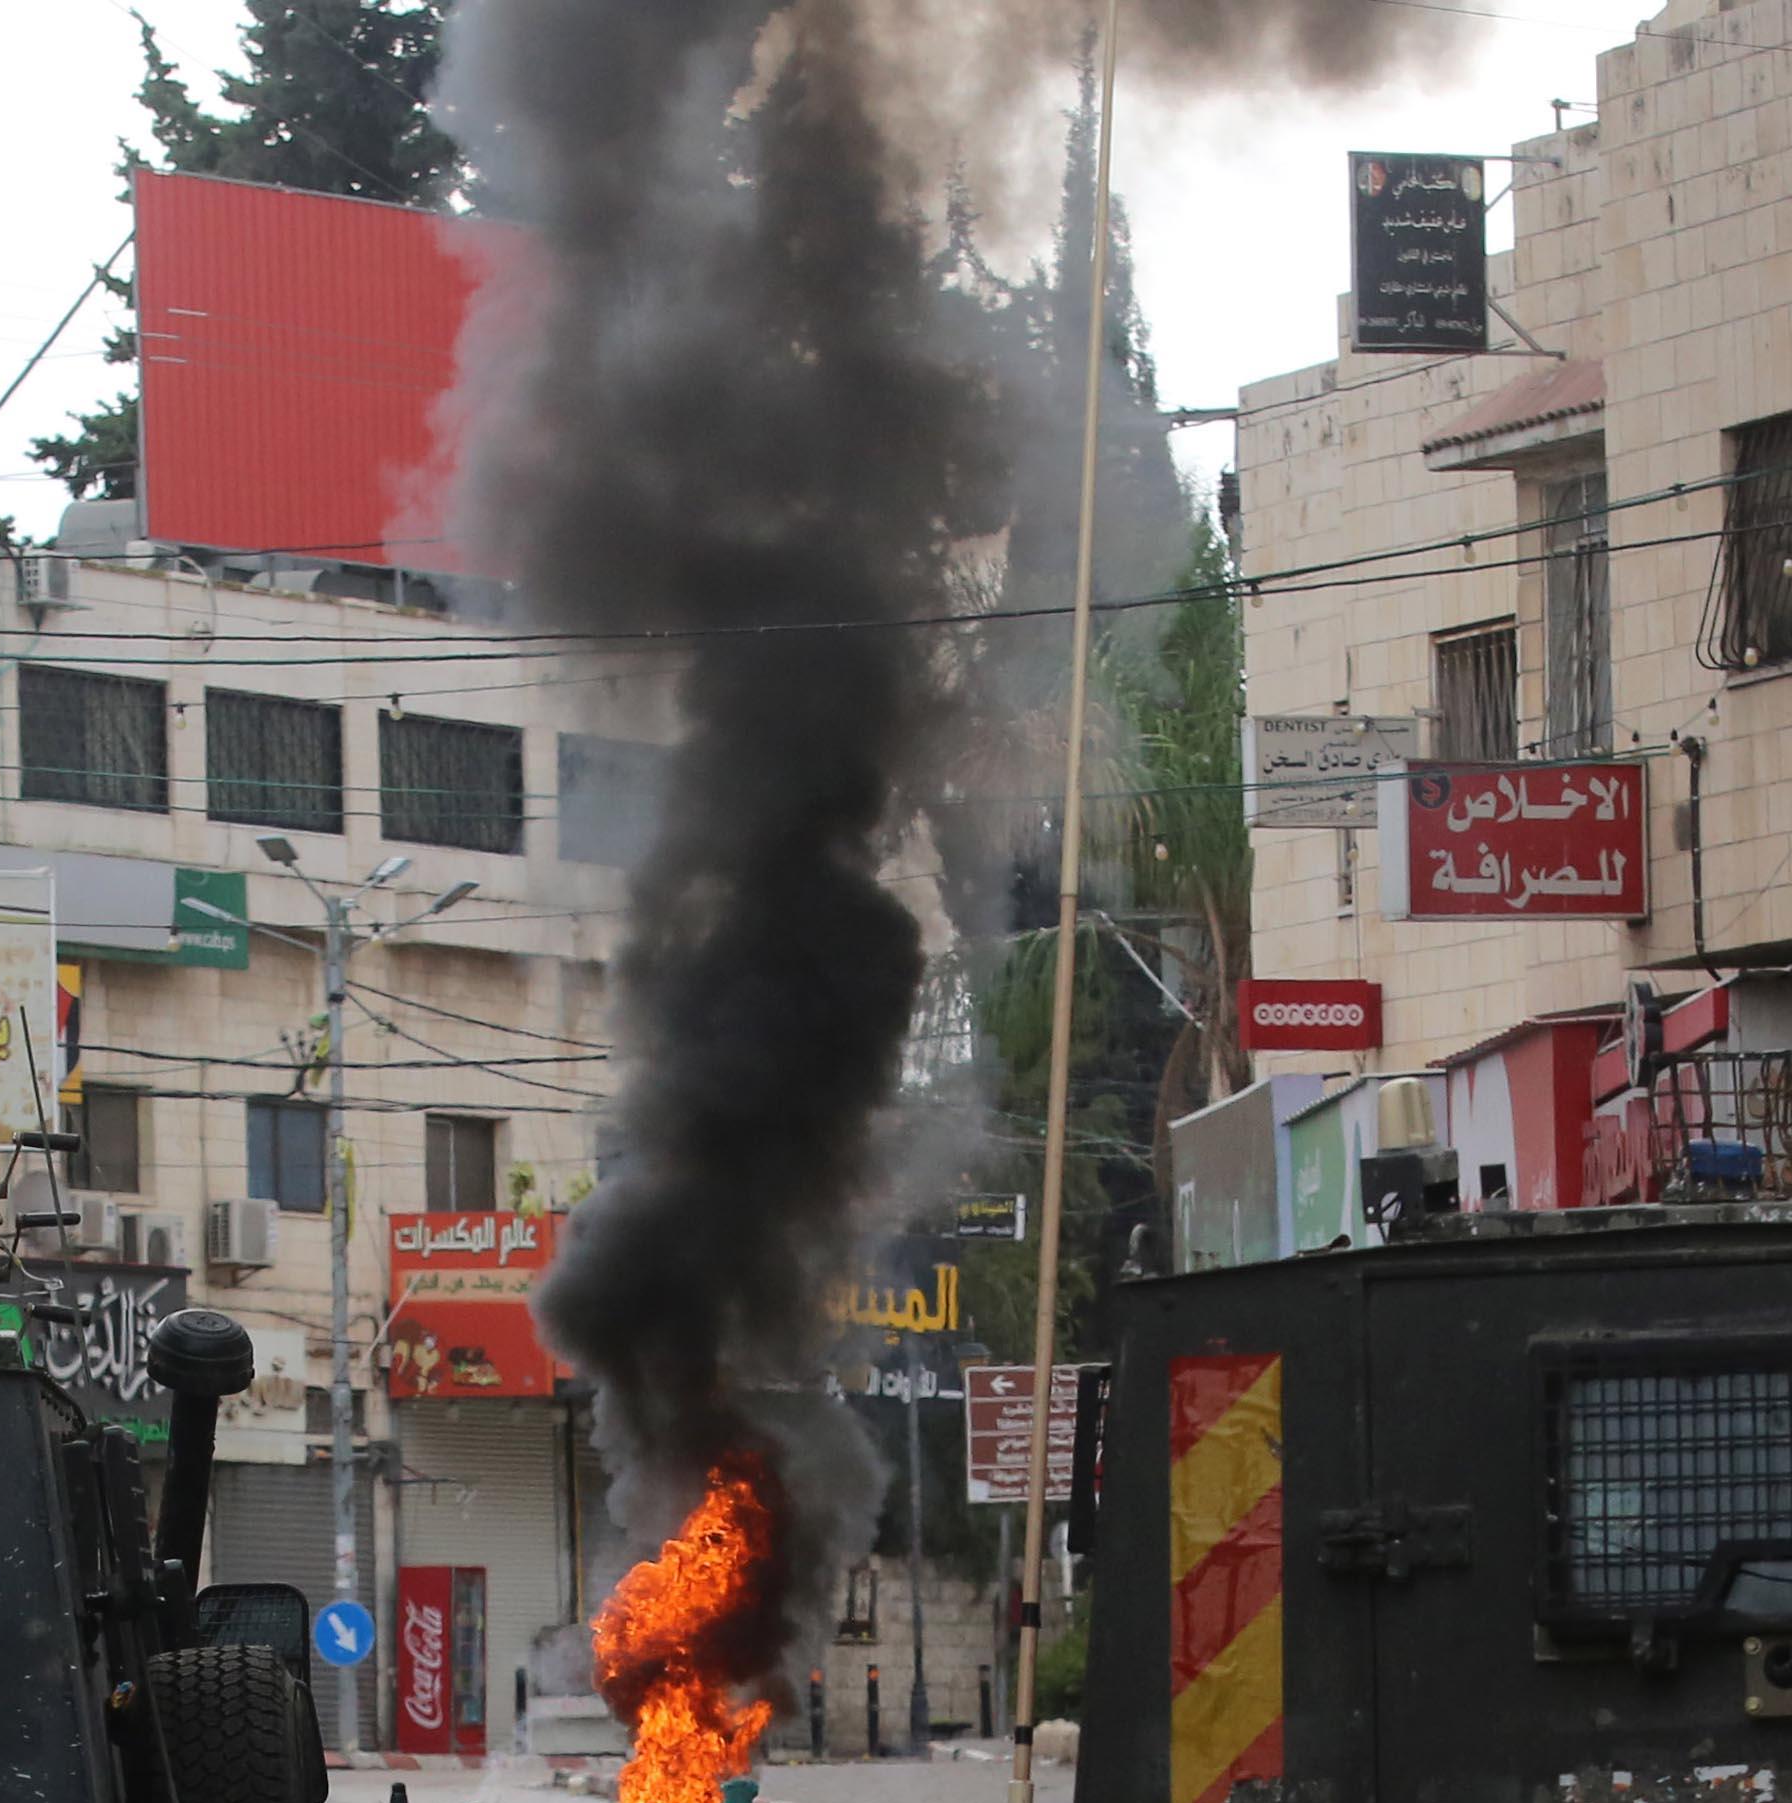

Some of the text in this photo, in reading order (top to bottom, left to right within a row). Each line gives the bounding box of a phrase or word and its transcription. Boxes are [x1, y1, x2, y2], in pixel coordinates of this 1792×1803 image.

[1264, 720, 1328, 733] DENTIST
[1445, 776, 1629, 832] الاخلاص
[1430, 844, 1628, 910] للصرافة
[1252, 1003, 1365, 1028] ooredoo
[394, 1216, 538, 1266] عالم المكسرات
